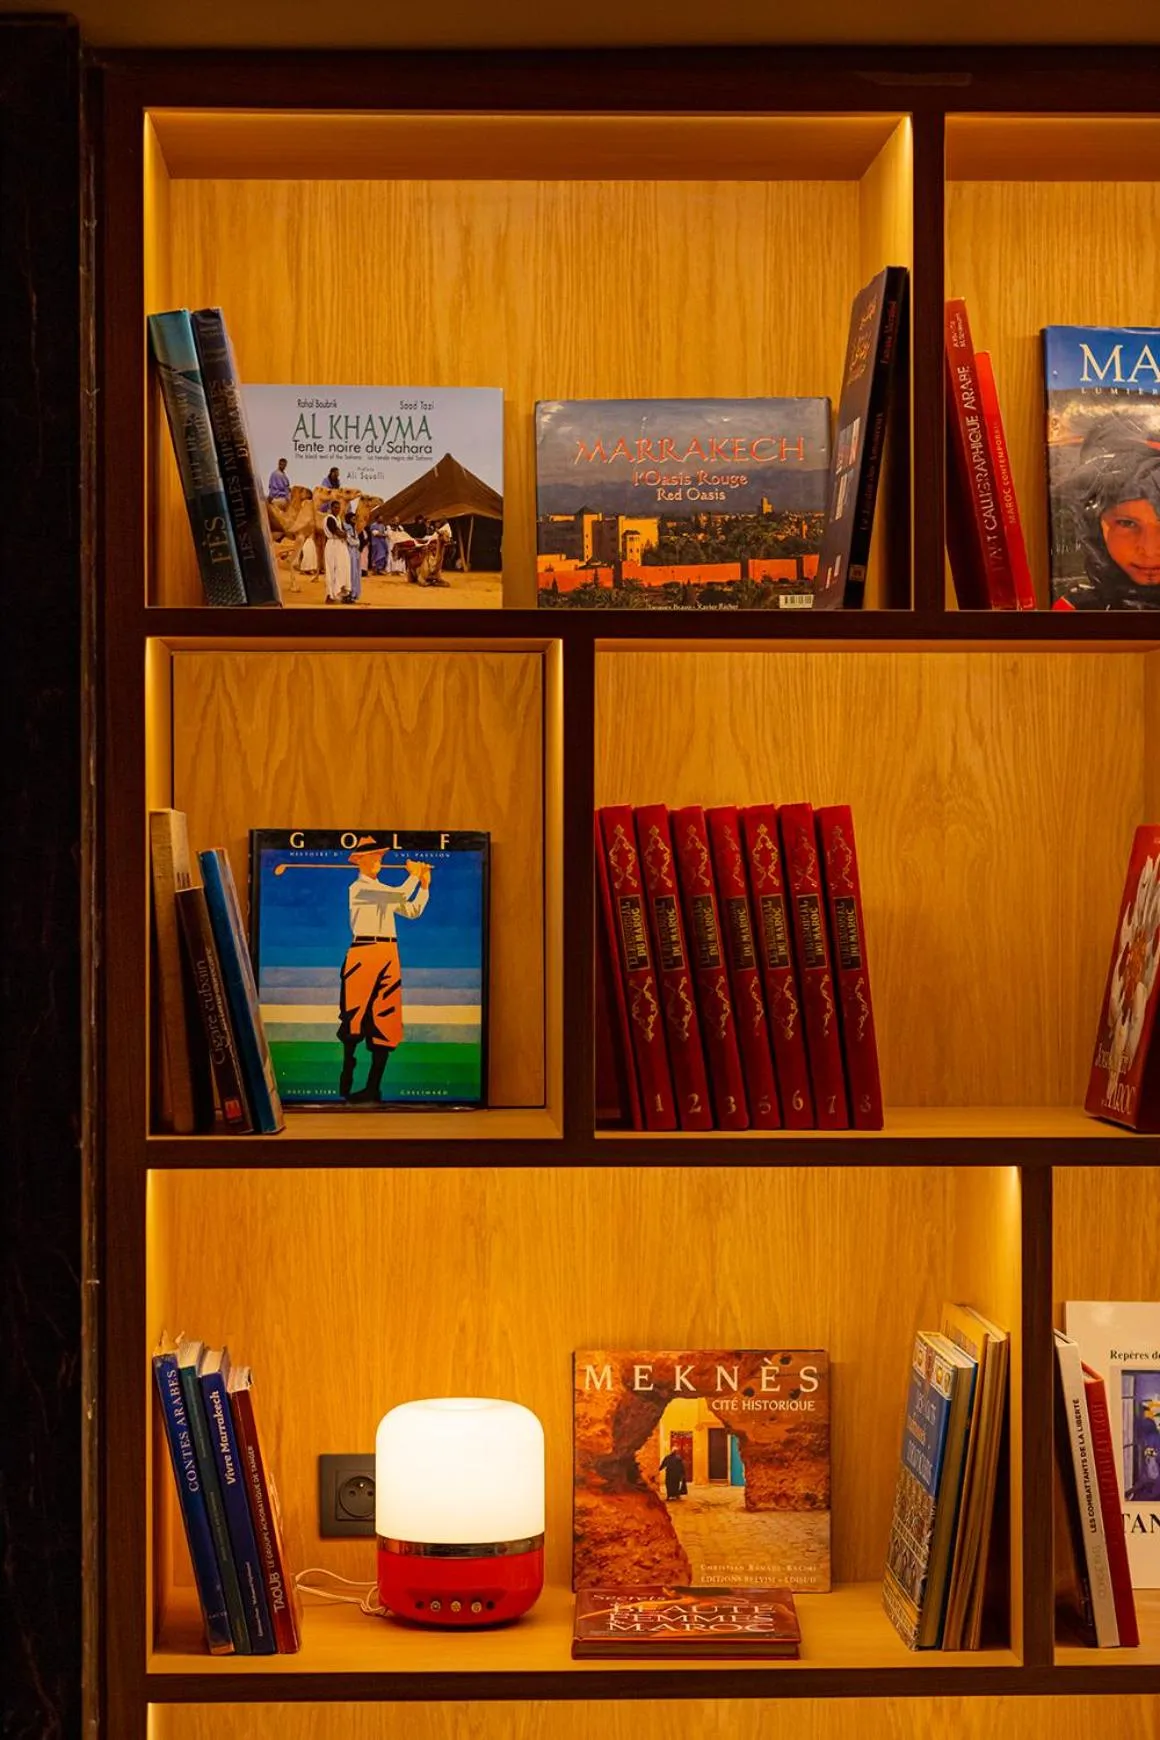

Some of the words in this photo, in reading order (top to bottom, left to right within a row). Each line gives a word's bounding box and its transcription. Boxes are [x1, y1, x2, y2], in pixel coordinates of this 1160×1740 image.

[957, 365, 977, 410] ARABE
[292, 413, 322, 441] AL
[329, 414, 432, 445] KHAYMA
[293, 440, 324, 453] Tente
[329, 441, 361, 453] noire
[365, 441, 382, 453] du
[387, 441, 432, 453] Sahara
[574, 436, 805, 465] MARRAKECH
[697, 470, 748, 488] Rouge
[965, 414, 998, 531] CALLIGRAPHIQUE
[227, 475, 247, 526] VILLES
[657, 487, 682, 501] Red
[686, 487, 726, 501] Oasis
[1001, 479, 1017, 523] MAROC
[202, 516, 231, 565] FÈS
[240, 532, 255, 560] LES
[289, 832, 450, 850] GOLF
[632, 907, 646, 942] MAROC
[666, 907, 681, 942] MAROC
[702, 907, 717, 942] MAROC
[737, 907, 752, 942] MAROC
[773, 907, 788, 942] MAROC
[810, 907, 825, 942] MAROC
[637, 942, 647, 957] DU
[672, 942, 682, 957] DU
[778, 942, 789, 957] DU
[207, 1014, 225, 1066] Cigare
[655, 1093, 664, 1112] 1
[688, 1093, 702, 1112] 2
[728, 1095, 737, 1114] 3
[758, 1095, 771, 1114] 5
[792, 1089, 803, 1111] 6
[828, 1094, 837, 1114] 7
[1152, 1350, 1160, 1360] d
[583, 1357, 819, 1392] MEKNÈS
[166, 1369, 186, 1426] ARABES
[712, 1397, 738, 1411] CITÉ
[742, 1399, 815, 1412] HISTORIQUE
[210, 1391, 232, 1453] Marrakech
[1071, 1397, 1083, 1432] LIBERTÉ
[1077, 1433, 1085, 1445] LA
[1079, 1446, 1087, 1457] DE
[179, 1431, 199, 1492] CONTES
[225, 1455, 236, 1485] Vivre
[247, 1445, 258, 1472] TANGER
[251, 1473, 260, 1482] DE
[1080, 1457, 1095, 1517] COMBATTANTS
[253, 1483, 269, 1530] ACROBATIQUE
[1088, 1517, 1097, 1533] LES
[262, 1532, 273, 1558] GROUPE
[268, 1559, 275, 1568] LE
[269, 1572, 286, 1613] TAOUB
[607, 1622, 776, 1632] MAROC
[608, 1614, 775, 1623] FEMMES
